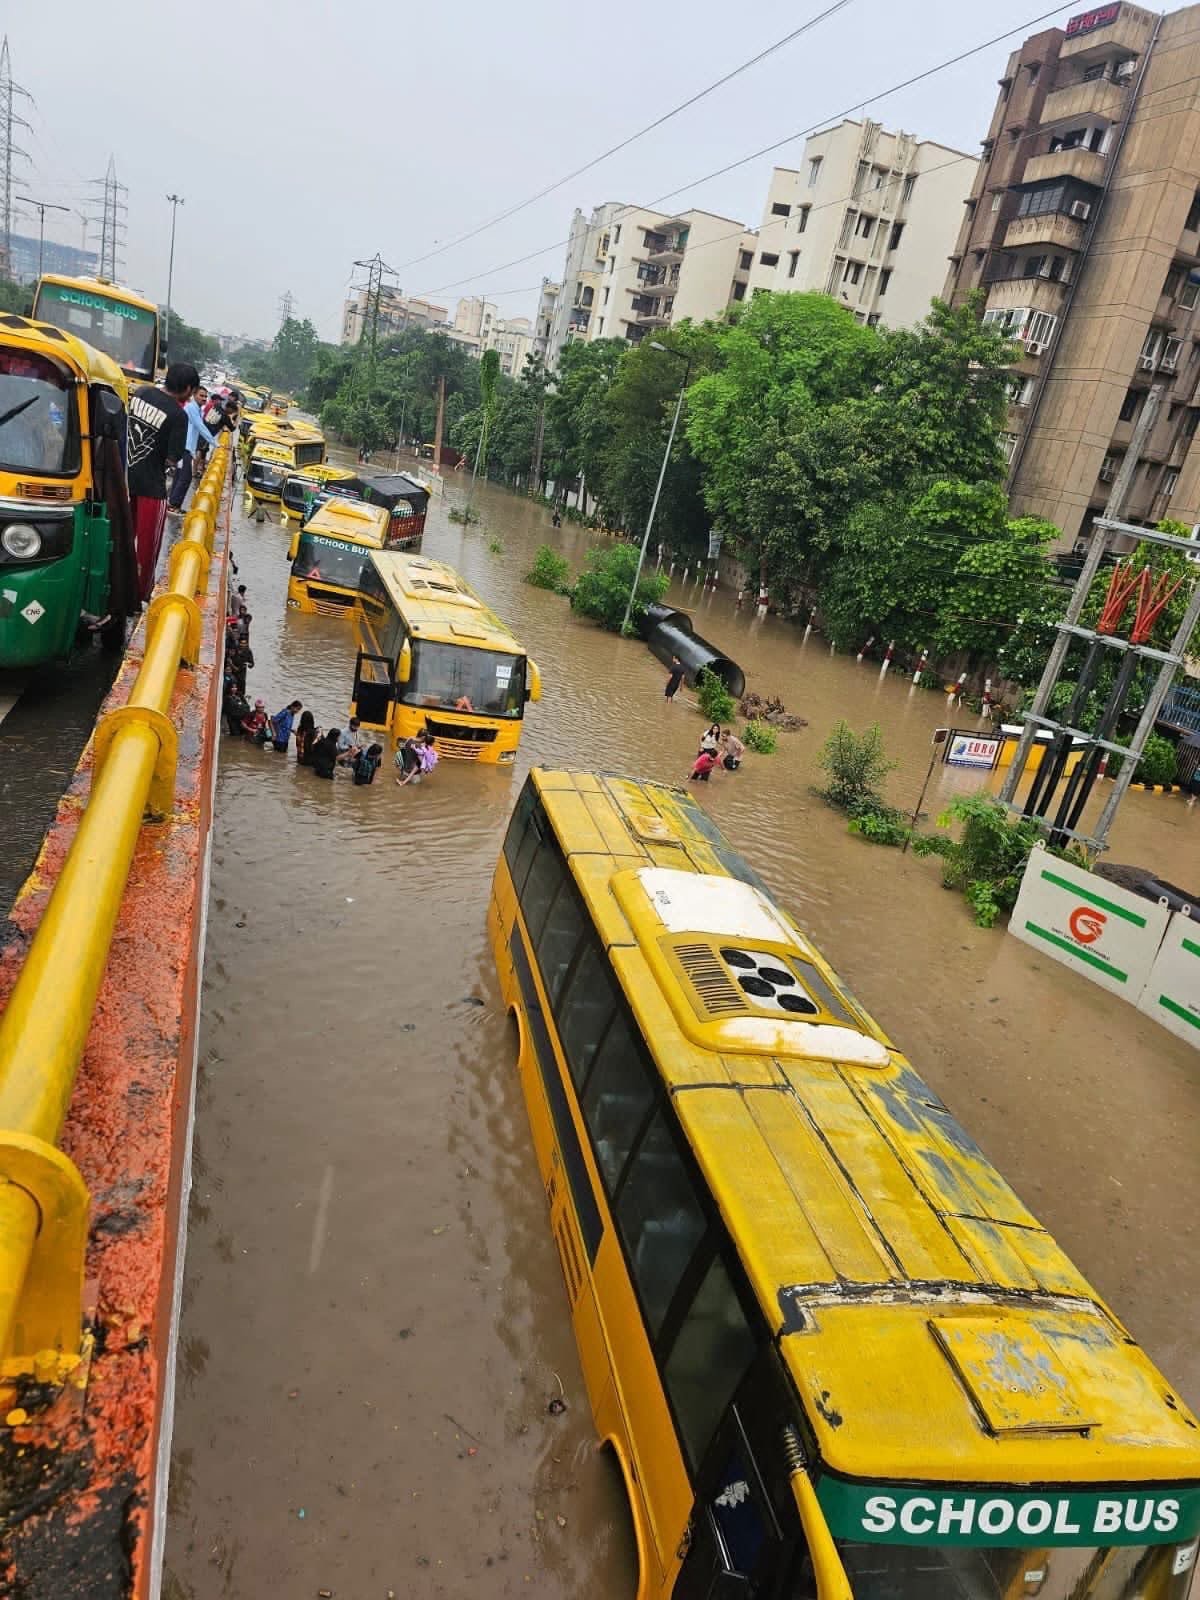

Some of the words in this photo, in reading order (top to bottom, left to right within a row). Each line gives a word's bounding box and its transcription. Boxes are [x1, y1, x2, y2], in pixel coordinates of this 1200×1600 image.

[59, 289, 110, 312] SCHOOL
[113, 305, 139, 321] BUS
[312, 535, 351, 552] SCHOOL
[861, 1496, 1081, 1535] SCHOOL
[1093, 1498, 1180, 1533] BUS
